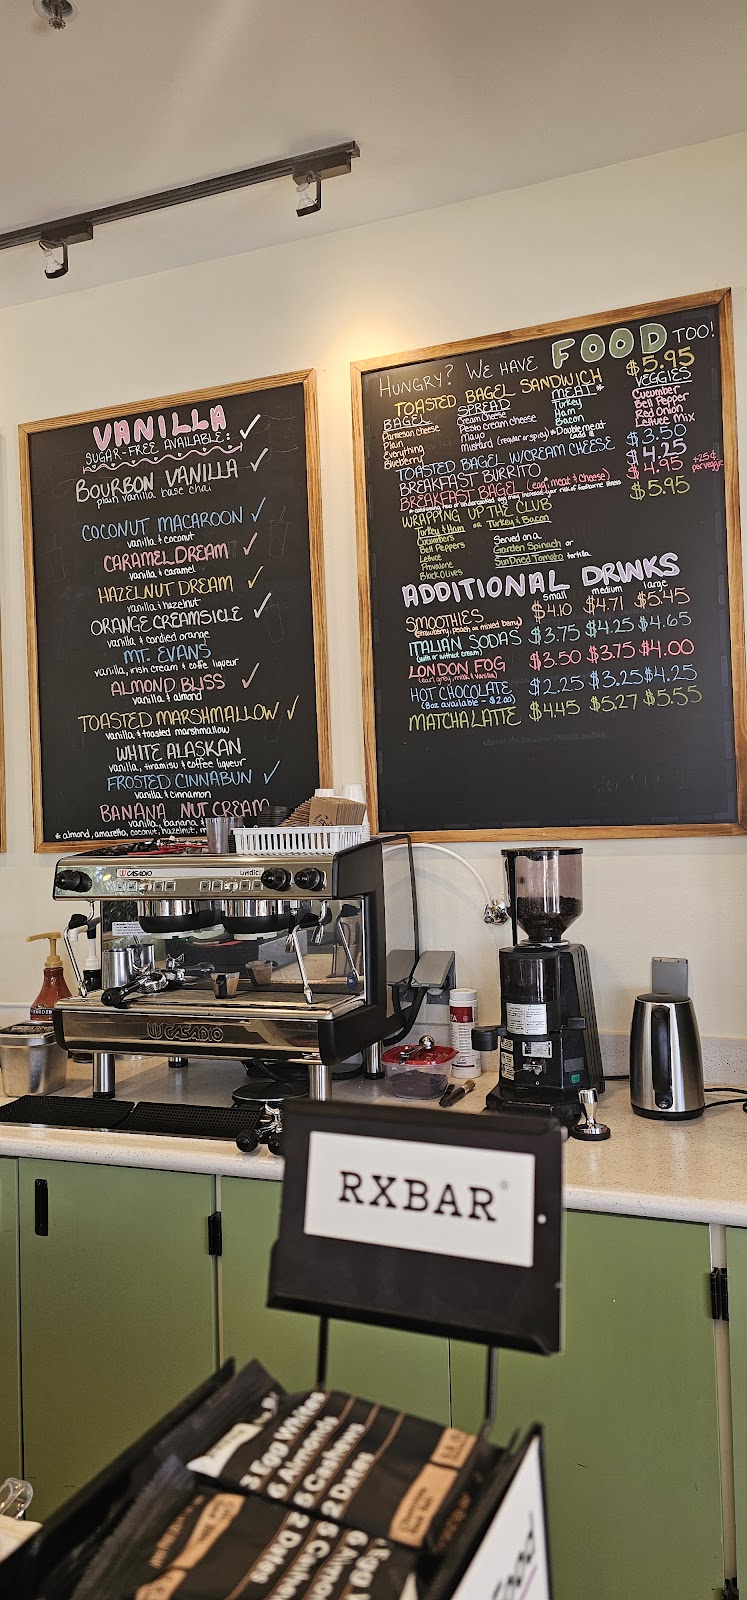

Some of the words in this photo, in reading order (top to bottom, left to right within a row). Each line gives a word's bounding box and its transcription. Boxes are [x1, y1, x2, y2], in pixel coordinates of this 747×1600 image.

[380, 364, 454, 397] HUNGRY?
[499, 355, 538, 376] HAVE
[551, 323, 667, 370] FOOD
[672, 321, 715, 343] TOO!
[626, 346, 695, 377] $5.95
[635, 367, 692, 388] VEGGIES
[394, 394, 457, 417] TOASTED
[465, 384, 516, 404] BAGEL
[519, 367, 603, 394] SANDWICH
[552, 398, 583, 410] Turkey
[632, 385, 681, 400] Cucumber
[634, 399, 654, 409] Bell
[655, 391, 690, 408] Pepper
[457, 399, 511, 416] SPREAD
[554, 408, 576, 418] Ham
[635, 409, 655, 420] Red
[656, 404, 684, 417] Onion
[674, 412, 696, 423] Mix
[93, 405, 226, 451] VANILLA
[383, 414, 432, 431] BAGEL
[555, 414, 585, 427] Bacon
[383, 440, 404, 451] Plain
[461, 432, 485, 444] Mayo
[626, 424, 687, 448] $3.50
[85, 442, 159, 466] SUGAR-FREE
[383, 445, 425, 460] Everything
[395, 461, 456, 482] TOASTED
[460, 453, 505, 471] BAGEL
[509, 443, 566, 466] W/CREAM
[568, 436, 616, 457] CHEESE
[626, 438, 688, 466] $4.25
[399, 472, 479, 497] BREAKFAST
[482, 463, 541, 484] BURRITO
[626, 456, 684, 480] $4.95
[76, 472, 154, 503] BOURBON
[165, 458, 239, 488] VANILLA
[630, 475, 691, 500] $5.95
[97, 495, 119, 509] plain
[121, 489, 156, 502] vanilla
[160, 486, 184, 498] base
[188, 483, 212, 494] chai
[400, 487, 476, 512] BREAKFAST
[478, 480, 523, 499] BAGEL
[81, 517, 151, 542] COCONUT
[157, 506, 244, 533] MACAROON
[402, 509, 461, 529] WRAPPING
[468, 505, 485, 521] UP
[485, 503, 515, 519] THE
[516, 498, 553, 514] CLUB
[127, 537, 158, 549] vanilla
[163, 532, 196, 544] coconut
[434, 542, 466, 553] Peppers
[526, 539, 562, 551] Spinach
[103, 551, 174, 573] CARAMEL
[174, 541, 229, 564] DREAM
[128, 569, 158, 582] vanilla
[164, 564, 196, 577] caramel
[402, 570, 570, 608] ADDITIONAL
[582, 552, 680, 587] DRINKS
[97, 581, 175, 604] HAZELNUT
[178, 575, 234, 596] DREAM
[543, 591, 567, 602] small
[591, 584, 623, 595] medium
[643, 578, 668, 592] large
[127, 601, 157, 613] vanilla
[163, 597, 201, 609] hazelnut
[406, 608, 484, 632] SMOOTHIES
[532, 600, 572, 624] $4.10
[583, 595, 624, 615] $4.71
[634, 587, 691, 609] $5.45
[90, 615, 153, 636] ORANGE
[152, 606, 243, 630] CREAMSICLE
[107, 635, 136, 648] vanilla
[146, 633, 177, 646] candied
[179, 630, 211, 645] orange
[409, 636, 463, 657] ITALIAN
[468, 629, 523, 650] SODAS
[528, 624, 581, 645] $3.75
[585, 617, 635, 638] $4.25
[638, 611, 692, 633] $4.65
[123, 648, 151, 665] MT.
[157, 643, 212, 663] EVANS
[409, 660, 469, 679] LONDON
[474, 655, 506, 673] FOG
[529, 649, 582, 671] $3.50
[586, 641, 636, 664] $3.75
[638, 638, 695, 658] $4.00
[94, 665, 130, 678] vanilla,
[150, 662, 178, 673] cream
[212, 657, 240, 671] liqueur
[110, 676, 176, 697] ALMOND
[181, 673, 226, 693] BLISS
[410, 686, 437, 703] HOT
[438, 680, 513, 701] CHOCOLATE
[528, 675, 585, 696] $2.25
[588, 669, 644, 690] $3.25
[644, 664, 698, 683] $4.25
[132, 694, 165, 706] vanilla
[173, 690, 203, 702] almond
[409, 709, 470, 732] MATCHA
[470, 706, 522, 728] LATTE
[529, 700, 581, 722] $4.45
[589, 693, 637, 712] $5.27
[643, 685, 703, 707] $5.55
[440, 699, 479, 709] available
[78, 711, 153, 733] TOASTED
[155, 701, 280, 726] MARSHMALLOW
[105, 729, 136, 741] vanilla
[141, 727, 172, 738] toasted
[174, 724, 230, 737] marshmallow
[116, 743, 164, 762] WHITE
[166, 737, 242, 760] ALASKAN
[108, 763, 142, 774] vanilla,
[186, 757, 214, 769] coffee
[216, 758, 247, 771] liqueur
[107, 772, 172, 792] FROSTED
[174, 769, 253, 790] CINNABUN
[134, 788, 164, 800] vanilla
[169, 789, 212, 800] cinnamon
[99, 801, 167, 824] BANANA
[180, 801, 210, 820] NUT
[338, 1171, 497, 1222] RXBAR
[278, 1415, 340, 1486] Almonds
[303, 1422, 366, 1493] Cashews
[329, 1451, 375, 1502] Dates
